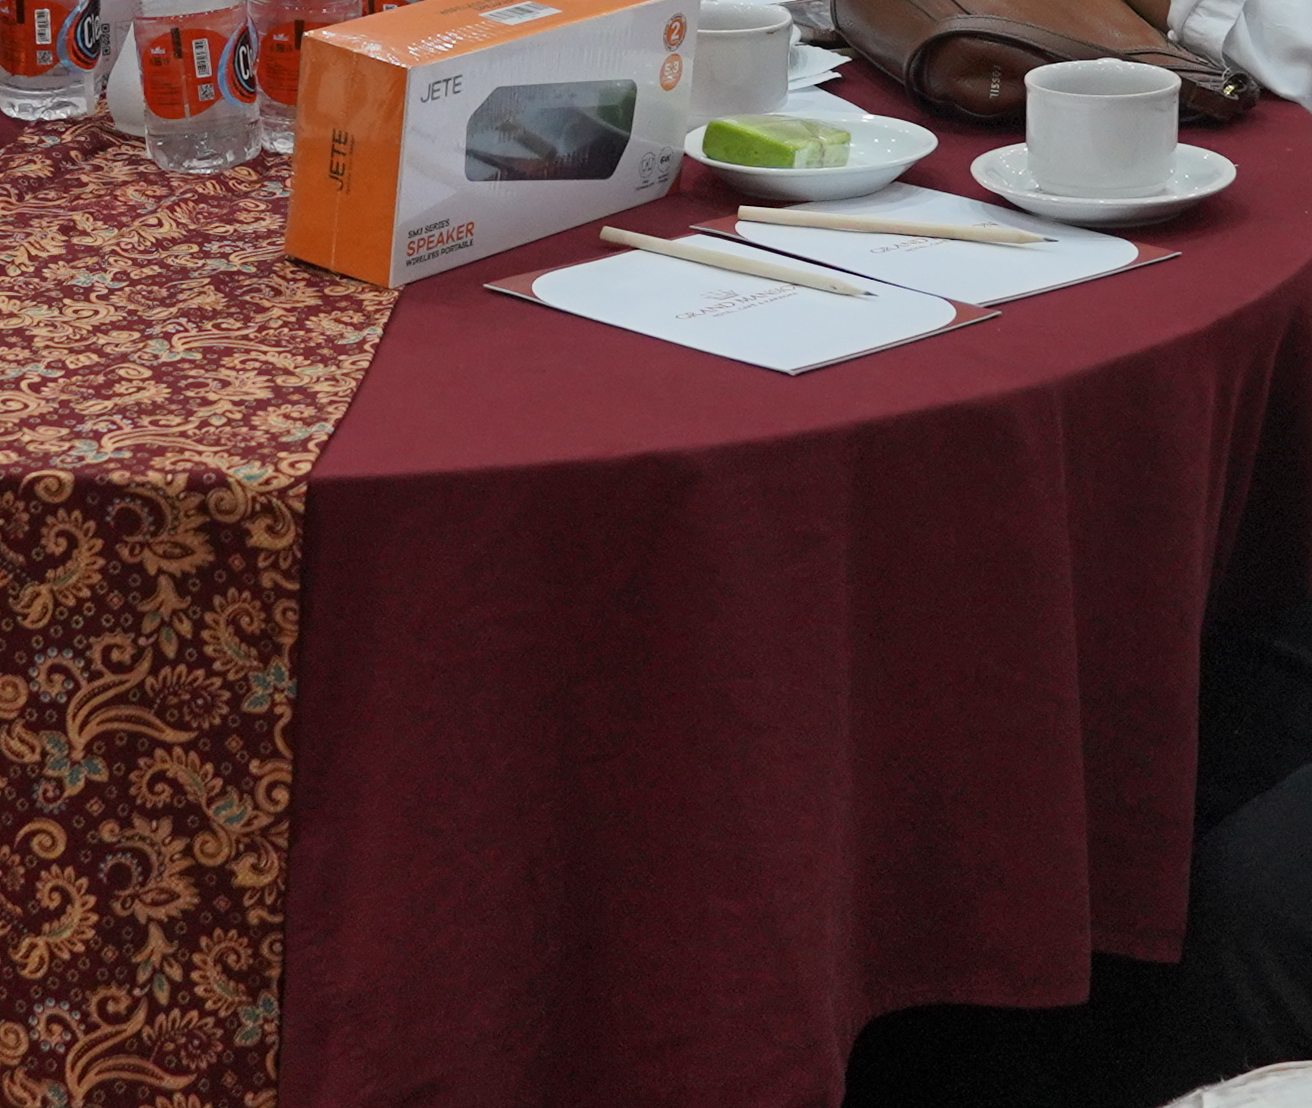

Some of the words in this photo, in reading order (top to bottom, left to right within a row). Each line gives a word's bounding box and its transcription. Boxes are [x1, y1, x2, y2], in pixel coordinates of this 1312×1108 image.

[420, 74, 463, 103] JETE
[329, 128, 349, 191] JETE
[406, 221, 476, 257] SPEAKER
[675, 301, 736, 319] GRAND
